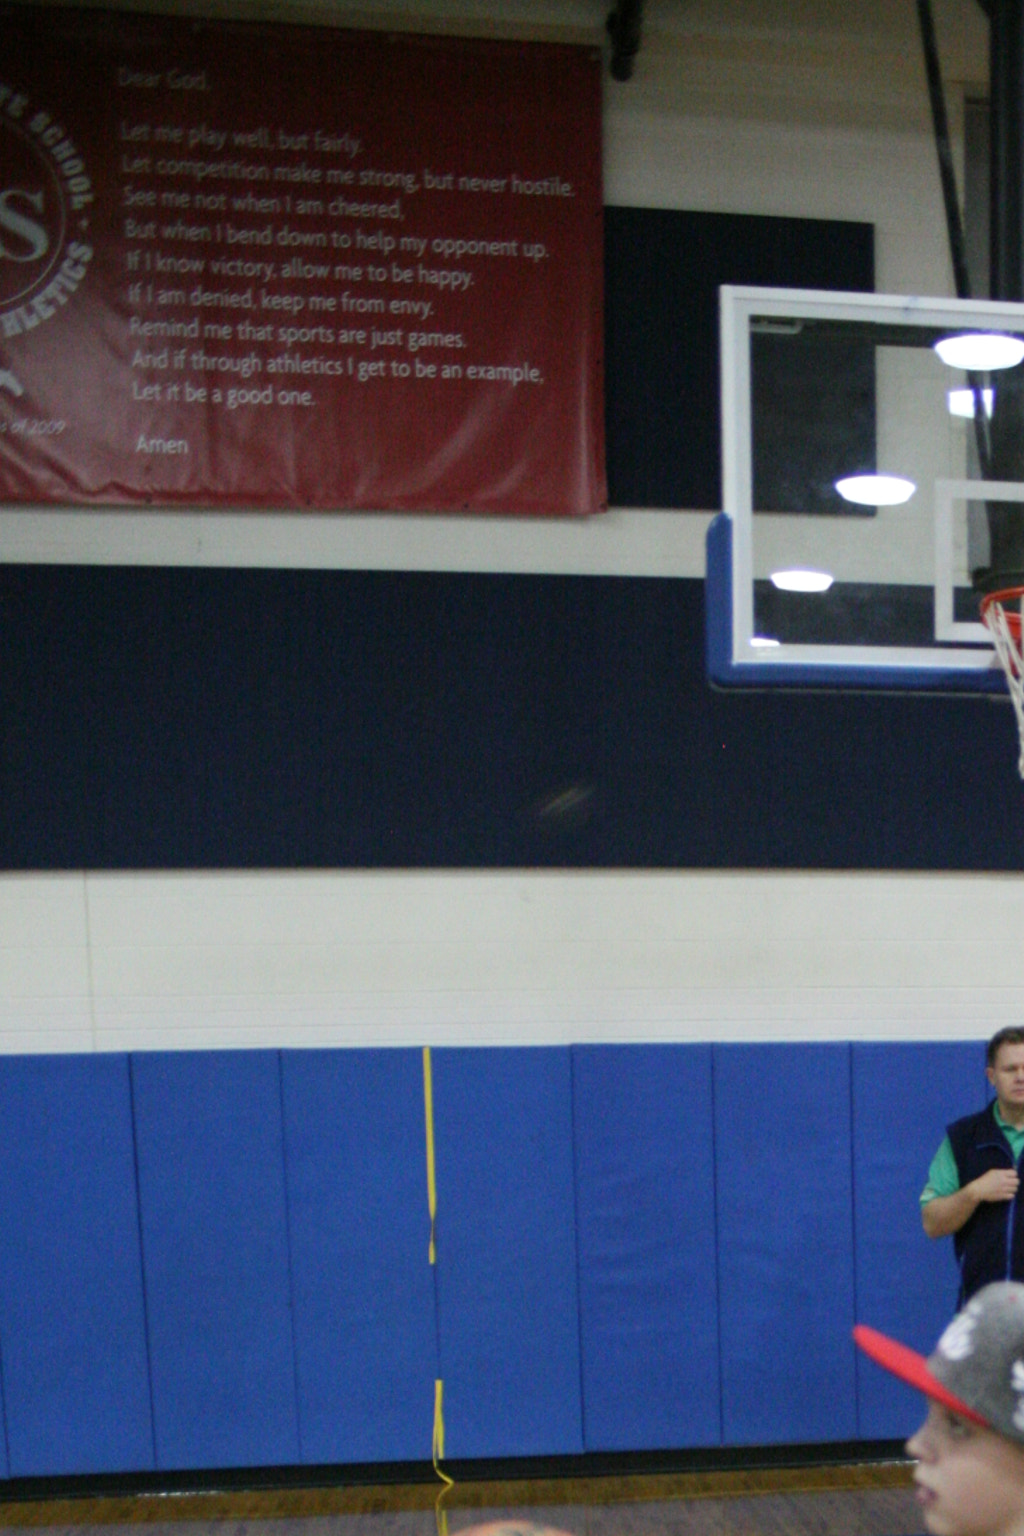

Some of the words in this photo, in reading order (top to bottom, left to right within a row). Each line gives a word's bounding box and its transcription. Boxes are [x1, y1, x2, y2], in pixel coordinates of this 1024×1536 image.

[118, 67, 160, 87] Dear
[120, 121, 150, 140] Let
[153, 126, 183, 142] me
[187, 122, 228, 150] play
[278, 129, 309, 150] but
[29, 111, 94, 210] SCHOOL
[121, 154, 150, 172] Let
[155, 158, 270, 182] competition
[273, 162, 322, 183] make
[326, 168, 354, 184] me
[423, 168, 454, 190] but
[458, 175, 507, 193] never
[123, 184, 156, 206] See
[161, 191, 190, 207] me
[194, 193, 227, 210] not
[232, 192, 281, 212] when
[295, 199, 323, 214] am
[125, 217, 156, 239] But
[161, 219, 211, 241] when
[226, 223, 273, 244] bend
[276, 225, 326, 246] down
[331, 231, 352, 247] to
[356, 229, 396, 255] help
[400, 236, 428, 257] my
[431, 238, 518, 260] opponent
[522, 242, 550, 264] up.
[127, 249, 142, 271] If
[156, 251, 204, 273] know
[280, 257, 330, 278] allow
[334, 264, 363, 280] me
[368, 265, 388, 281] to
[391, 262, 414, 283] be
[418, 264, 475, 291] happy.
[0, 241, 93, 338] HLETICS
[128, 282, 143, 303] If
[157, 288, 186, 305] am
[261, 288, 304, 315] keep
[309, 295, 337, 311] me
[341, 291, 385, 313] from
[389, 298, 434, 320] envy.
[130, 316, 199, 338] Remind
[203, 323, 233, 340] me
[236, 319, 274, 341] that
[278, 324, 335, 347] sports
[338, 329, 367, 344] are
[370, 326, 403, 350] just
[407, 332, 467, 352] games.
[131, 349, 168, 369] And
[173, 349, 187, 369] if
[191, 350, 262, 378] through
[266, 353, 343, 375] athletics
[358, 361, 386, 382] get
[390, 361, 410, 378] to
[415, 357, 437, 379] be
[441, 364, 462, 379] an
[132, 380, 161, 401] Let
[167, 382, 180, 401] it
[185, 380, 207, 402] be
[212, 388, 222, 403] a
[226, 384, 274, 409] good
[277, 388, 317, 406] one.
[134, 433, 189, 454] Amen
